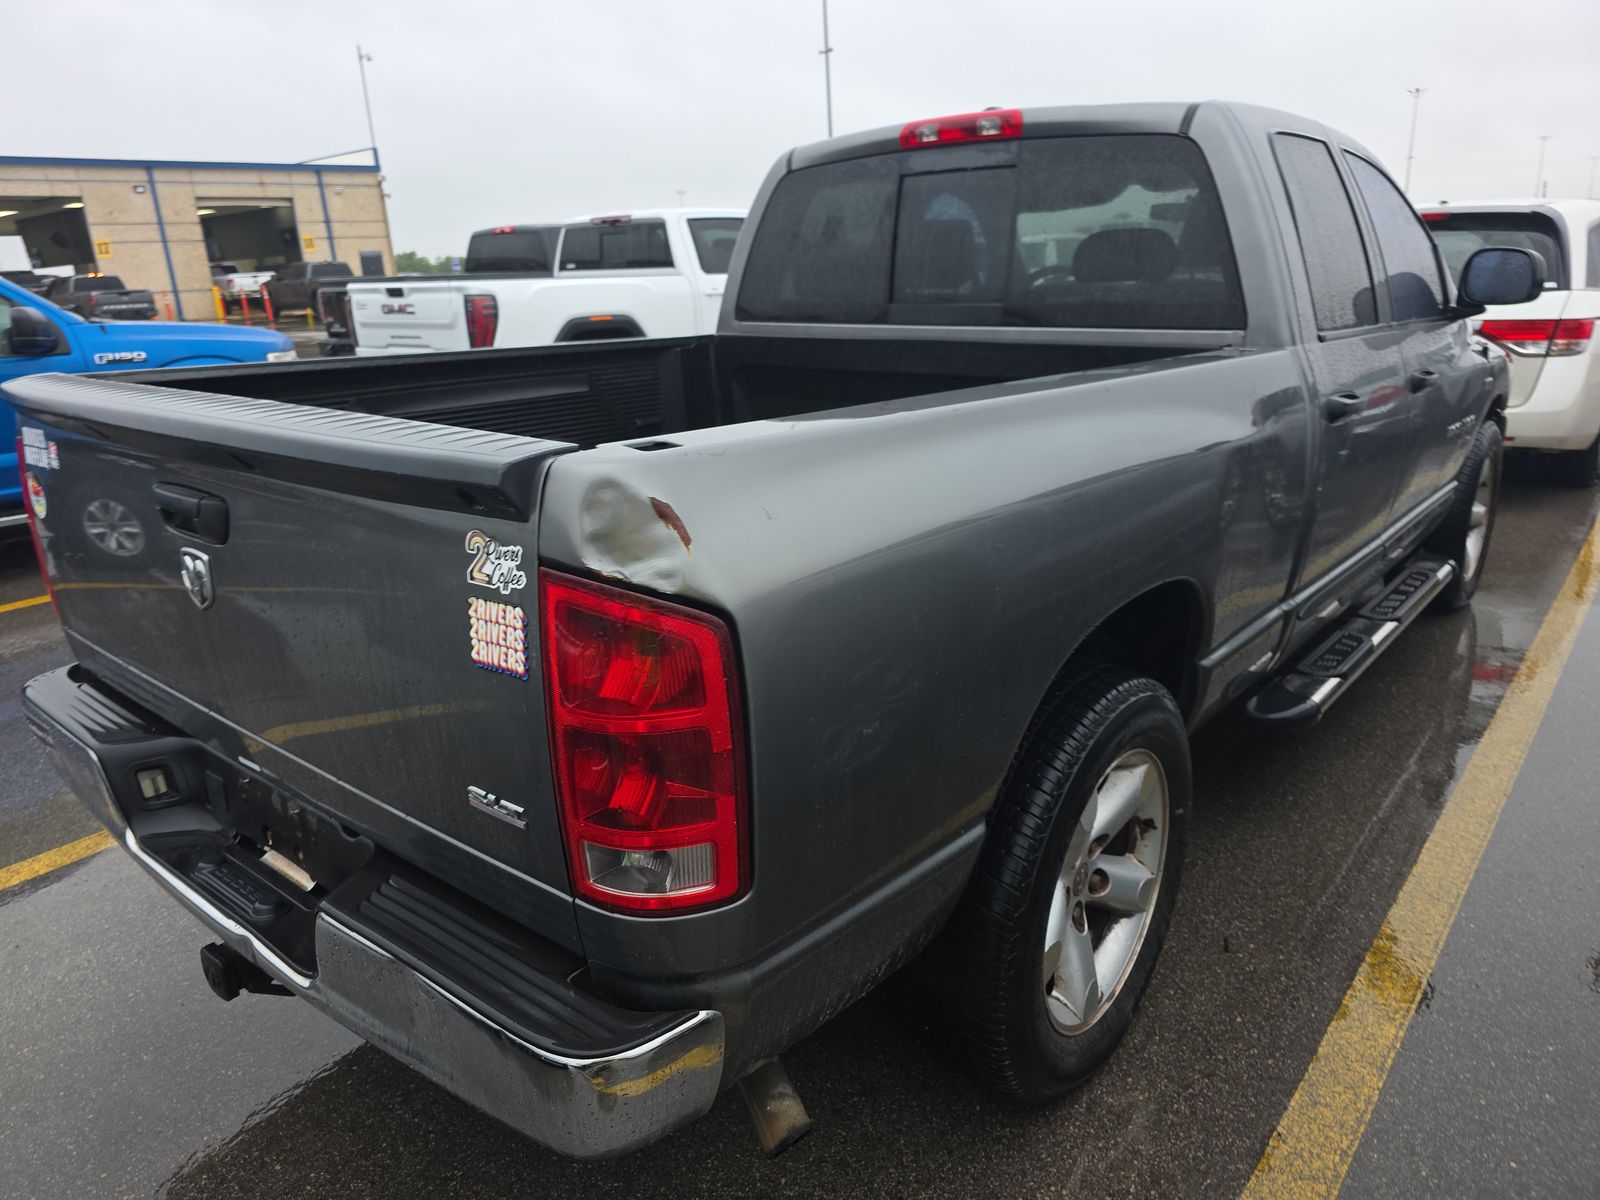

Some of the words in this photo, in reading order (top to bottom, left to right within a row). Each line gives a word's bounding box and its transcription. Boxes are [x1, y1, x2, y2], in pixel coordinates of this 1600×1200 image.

[381, 304, 416, 315] GMC
[465, 530, 490, 584] 2
[486, 539, 520, 565] Rivers
[491, 563, 525, 591] Coffee
